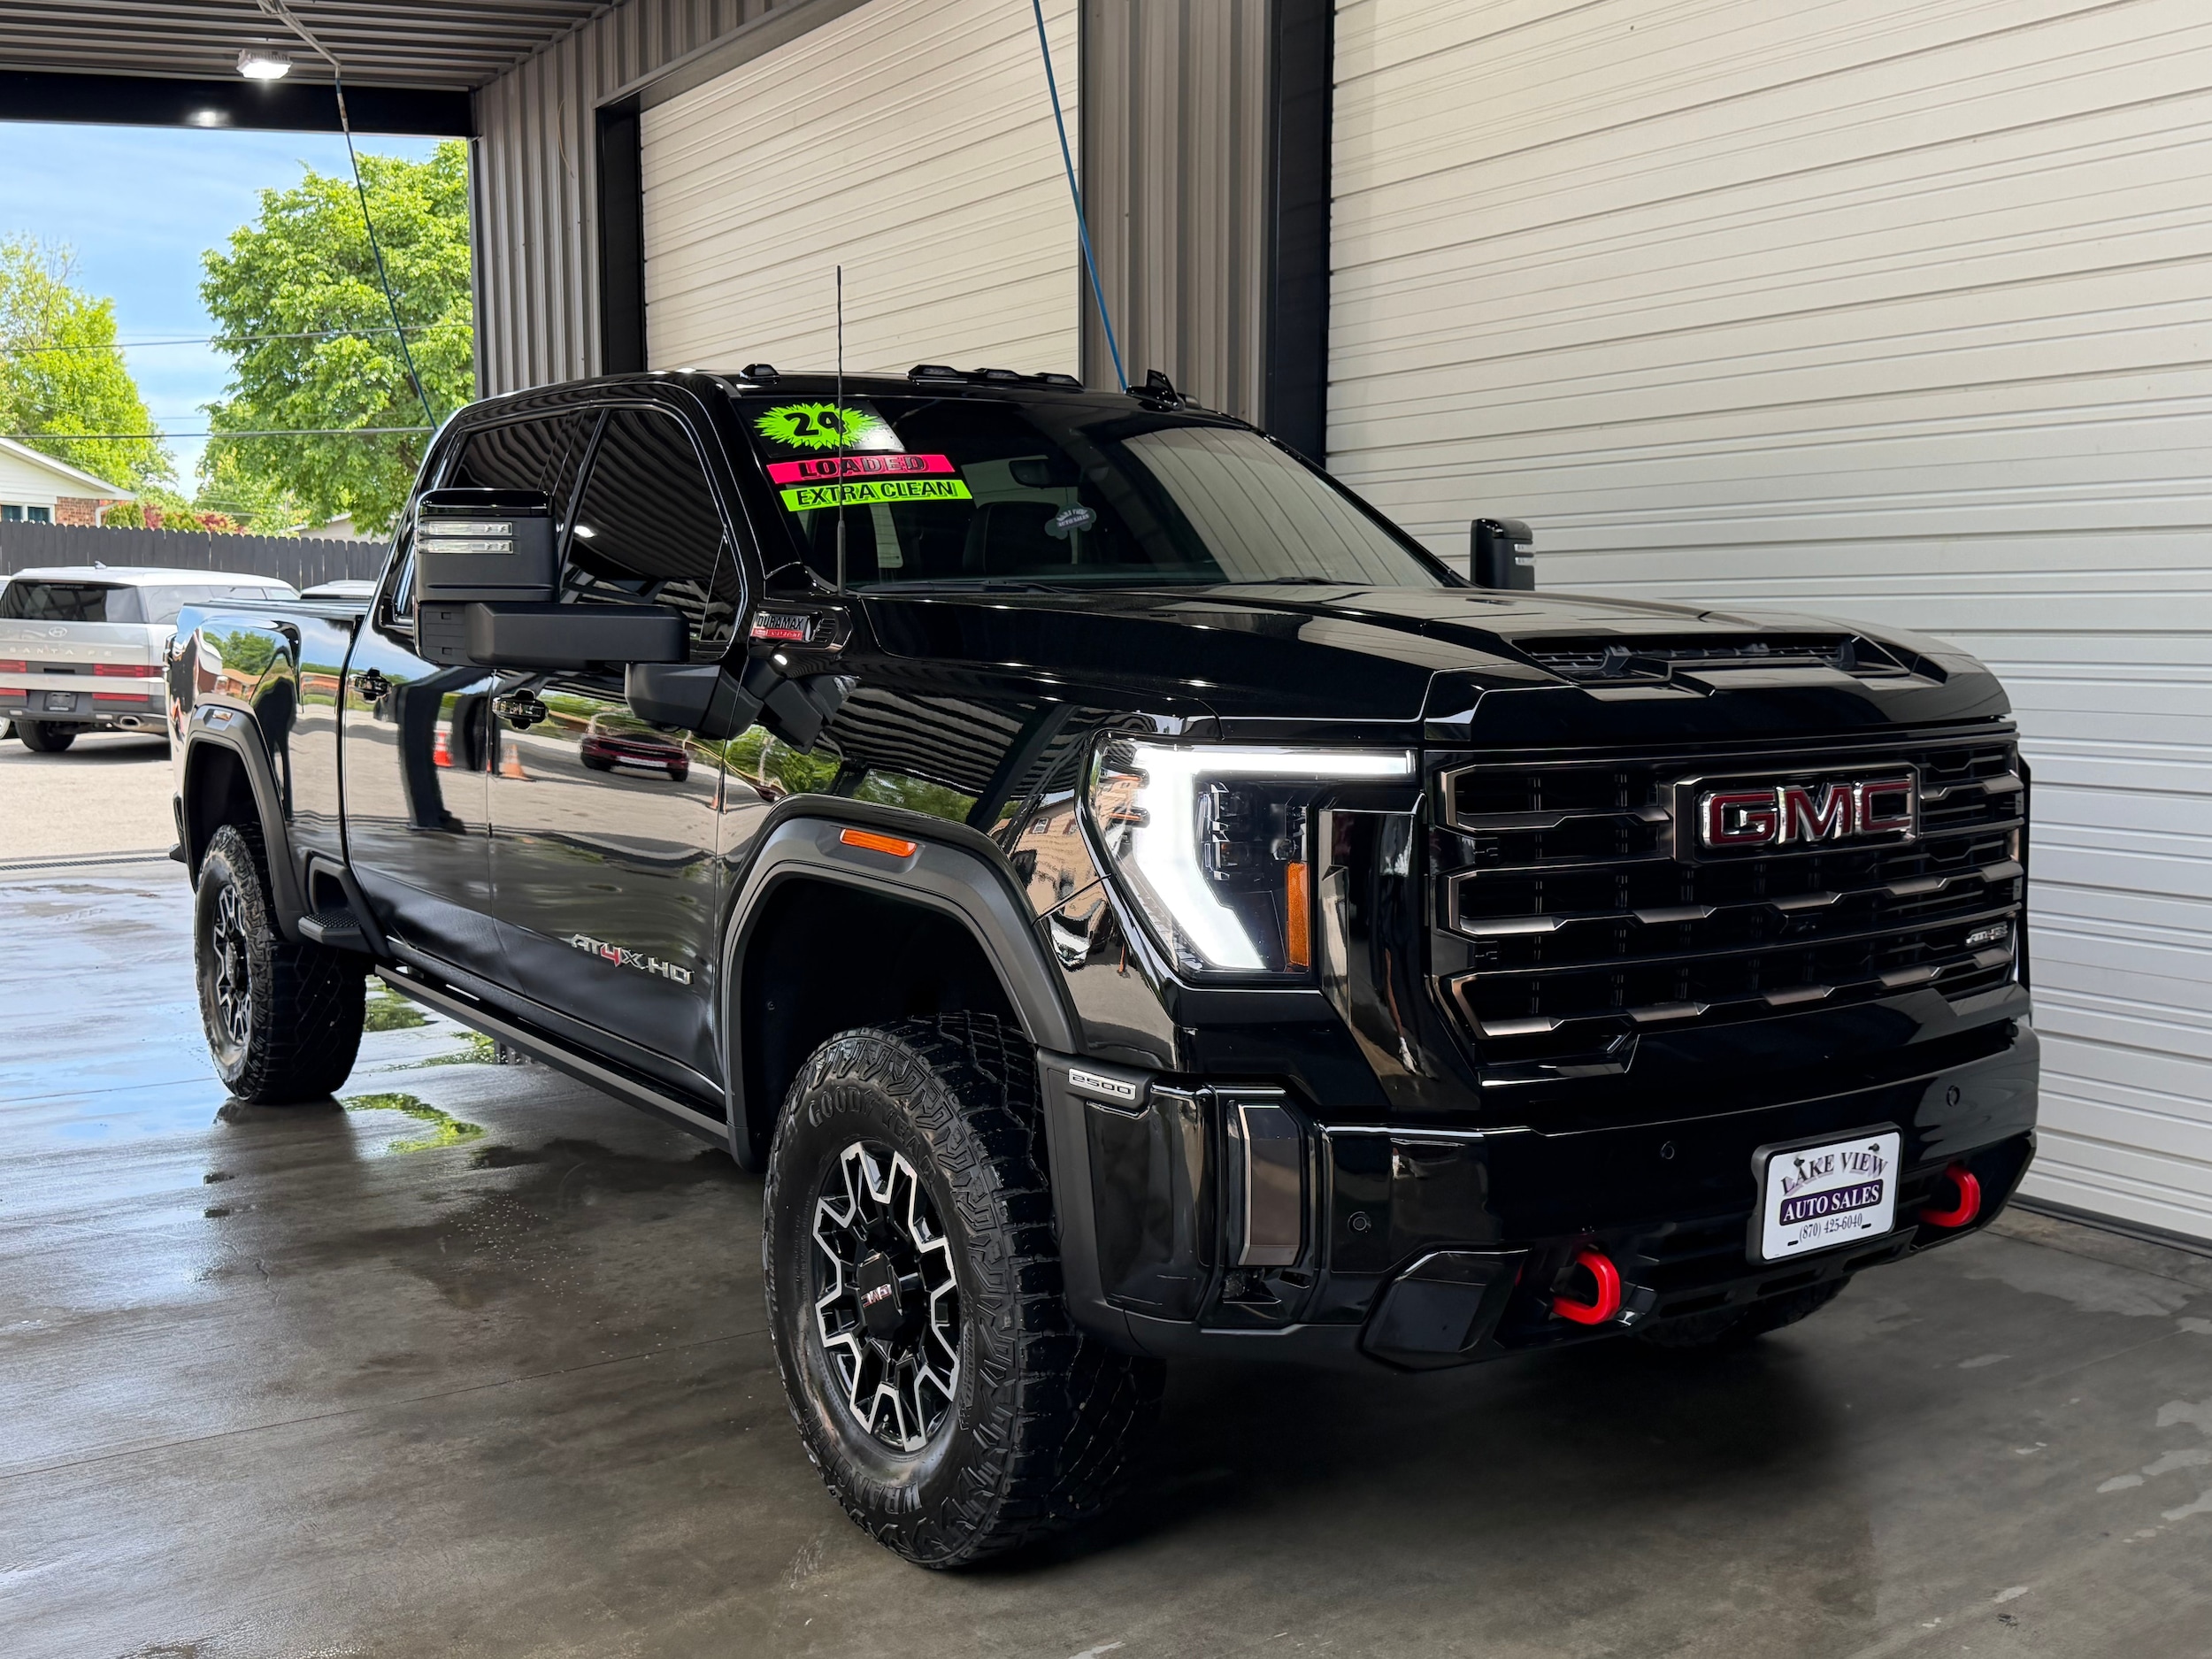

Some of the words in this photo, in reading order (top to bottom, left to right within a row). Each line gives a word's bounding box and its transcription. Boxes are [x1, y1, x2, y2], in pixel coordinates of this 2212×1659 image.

[783, 411, 848, 437] 24
[798, 456, 926, 479] LOADED
[796, 483, 875, 506] EXTRA
[880, 480, 955, 498] CLEAN
[757, 615, 804, 630] DURAMAX
[9, 646, 74, 656] SANTA
[1699, 778, 1912, 849] GMC
[1071, 1073, 1132, 1094] 2500
[1780, 1154, 1835, 1195] LAKE
[1840, 1151, 1889, 1178] VIEW
[1783, 1195, 1829, 1223] AUTO
[1831, 1184, 1880, 1211] SALES
[1799, 1223, 1822, 1242] (870)
[1824, 1213, 1863, 1234] 425-6040
[861, 1283, 893, 1308] GMC
